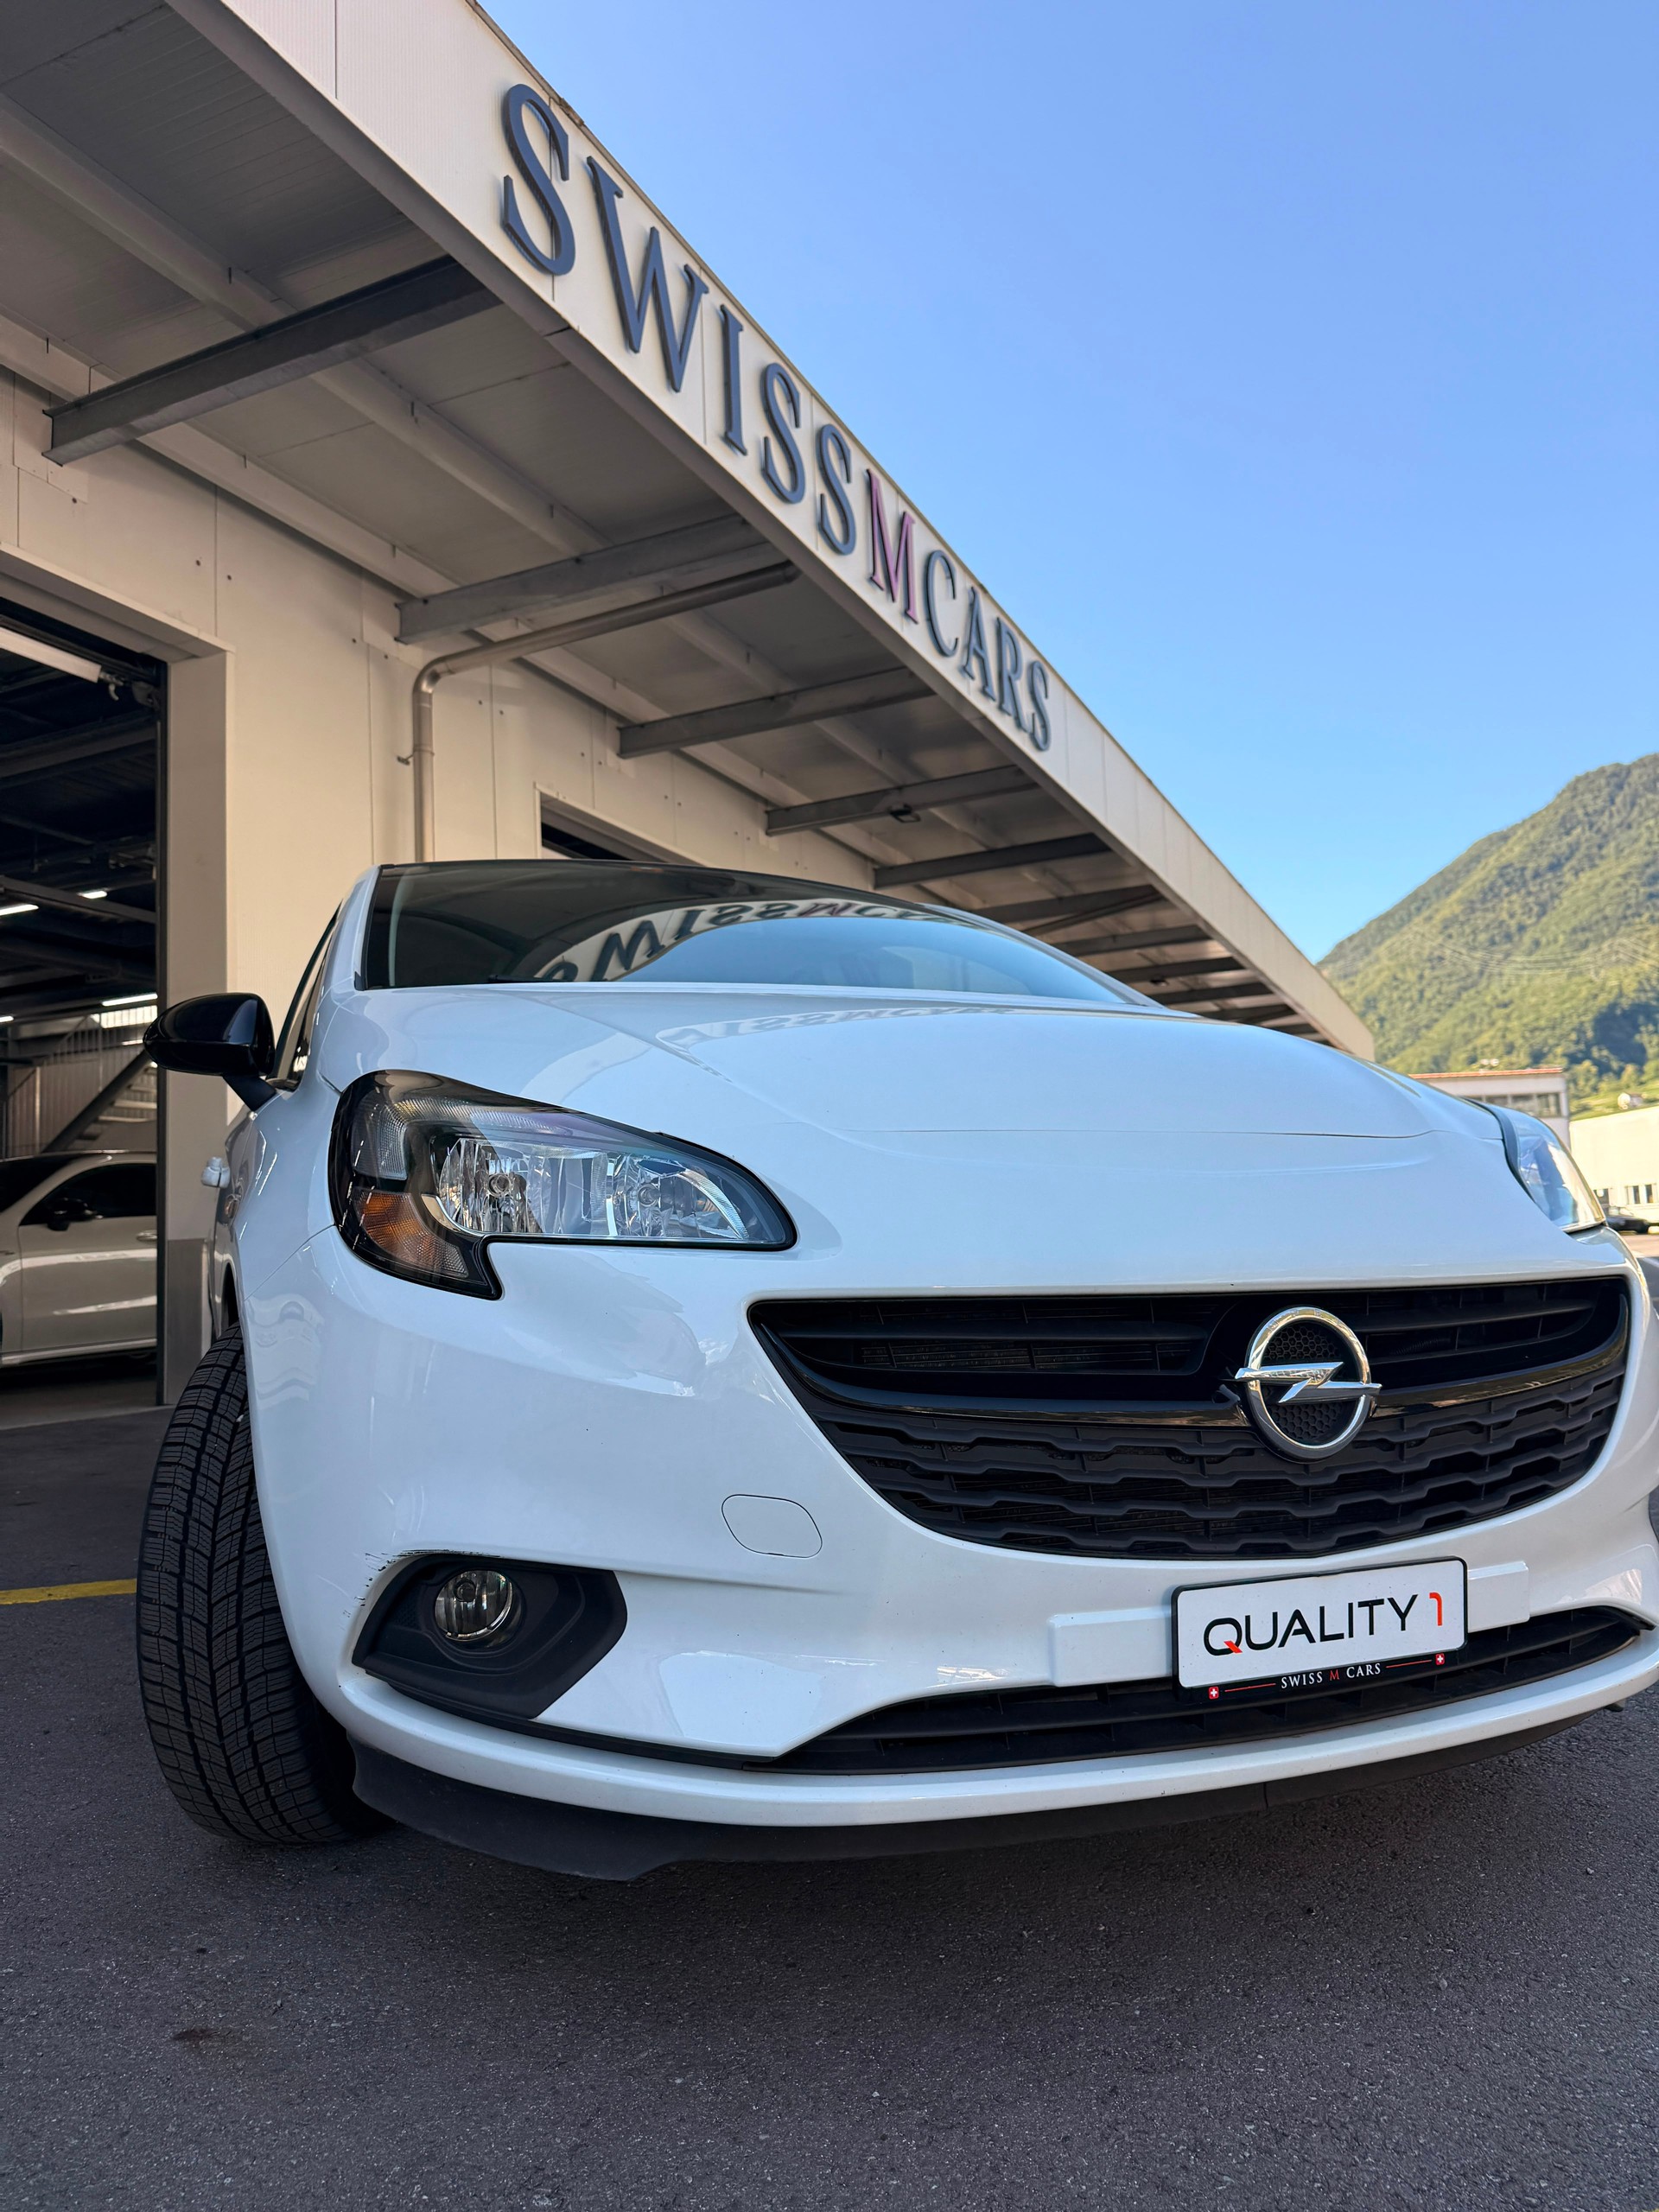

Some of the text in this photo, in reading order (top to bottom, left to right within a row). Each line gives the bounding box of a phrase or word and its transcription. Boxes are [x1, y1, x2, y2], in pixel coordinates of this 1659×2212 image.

[1203, 1592, 1443, 1656] QUALITY 1
[1281, 1662, 1381, 1689] SWISS M CARS
